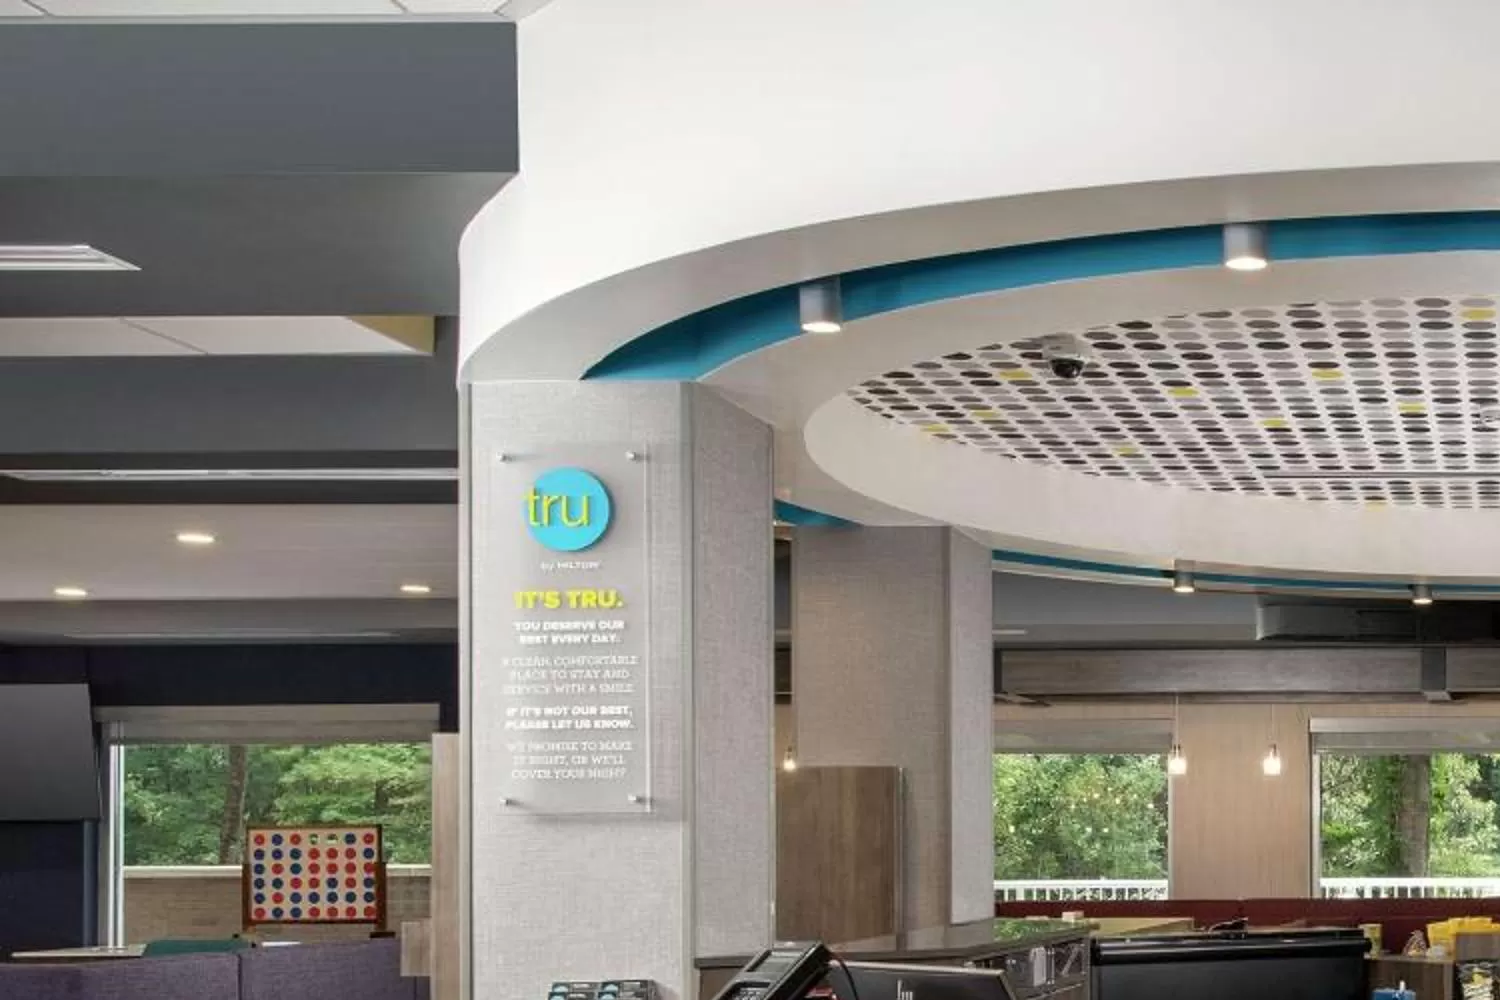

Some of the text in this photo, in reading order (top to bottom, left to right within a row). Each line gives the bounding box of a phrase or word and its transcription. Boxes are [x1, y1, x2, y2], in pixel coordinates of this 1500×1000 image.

[525, 488, 590, 527] tru
[514, 588, 624, 608] IT'S TRU.
